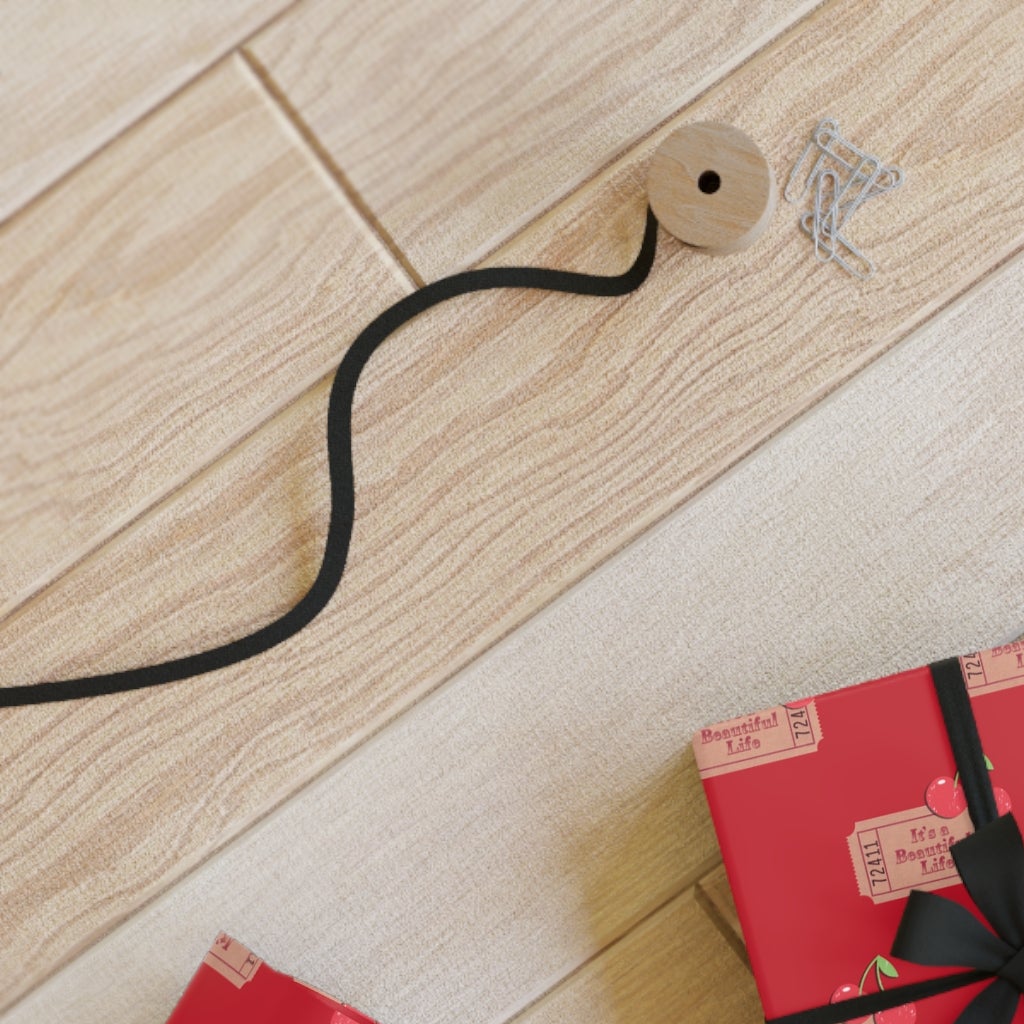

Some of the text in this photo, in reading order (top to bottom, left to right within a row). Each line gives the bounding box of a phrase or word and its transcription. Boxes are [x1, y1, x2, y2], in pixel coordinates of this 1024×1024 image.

[701, 711, 778, 745] Beautiful
[790, 710, 811, 740] 724
[726, 736, 761, 756] Life
[910, 825, 950, 844] It's a
[864, 840, 887, 887] 72411
[921, 856, 956, 875] Life
